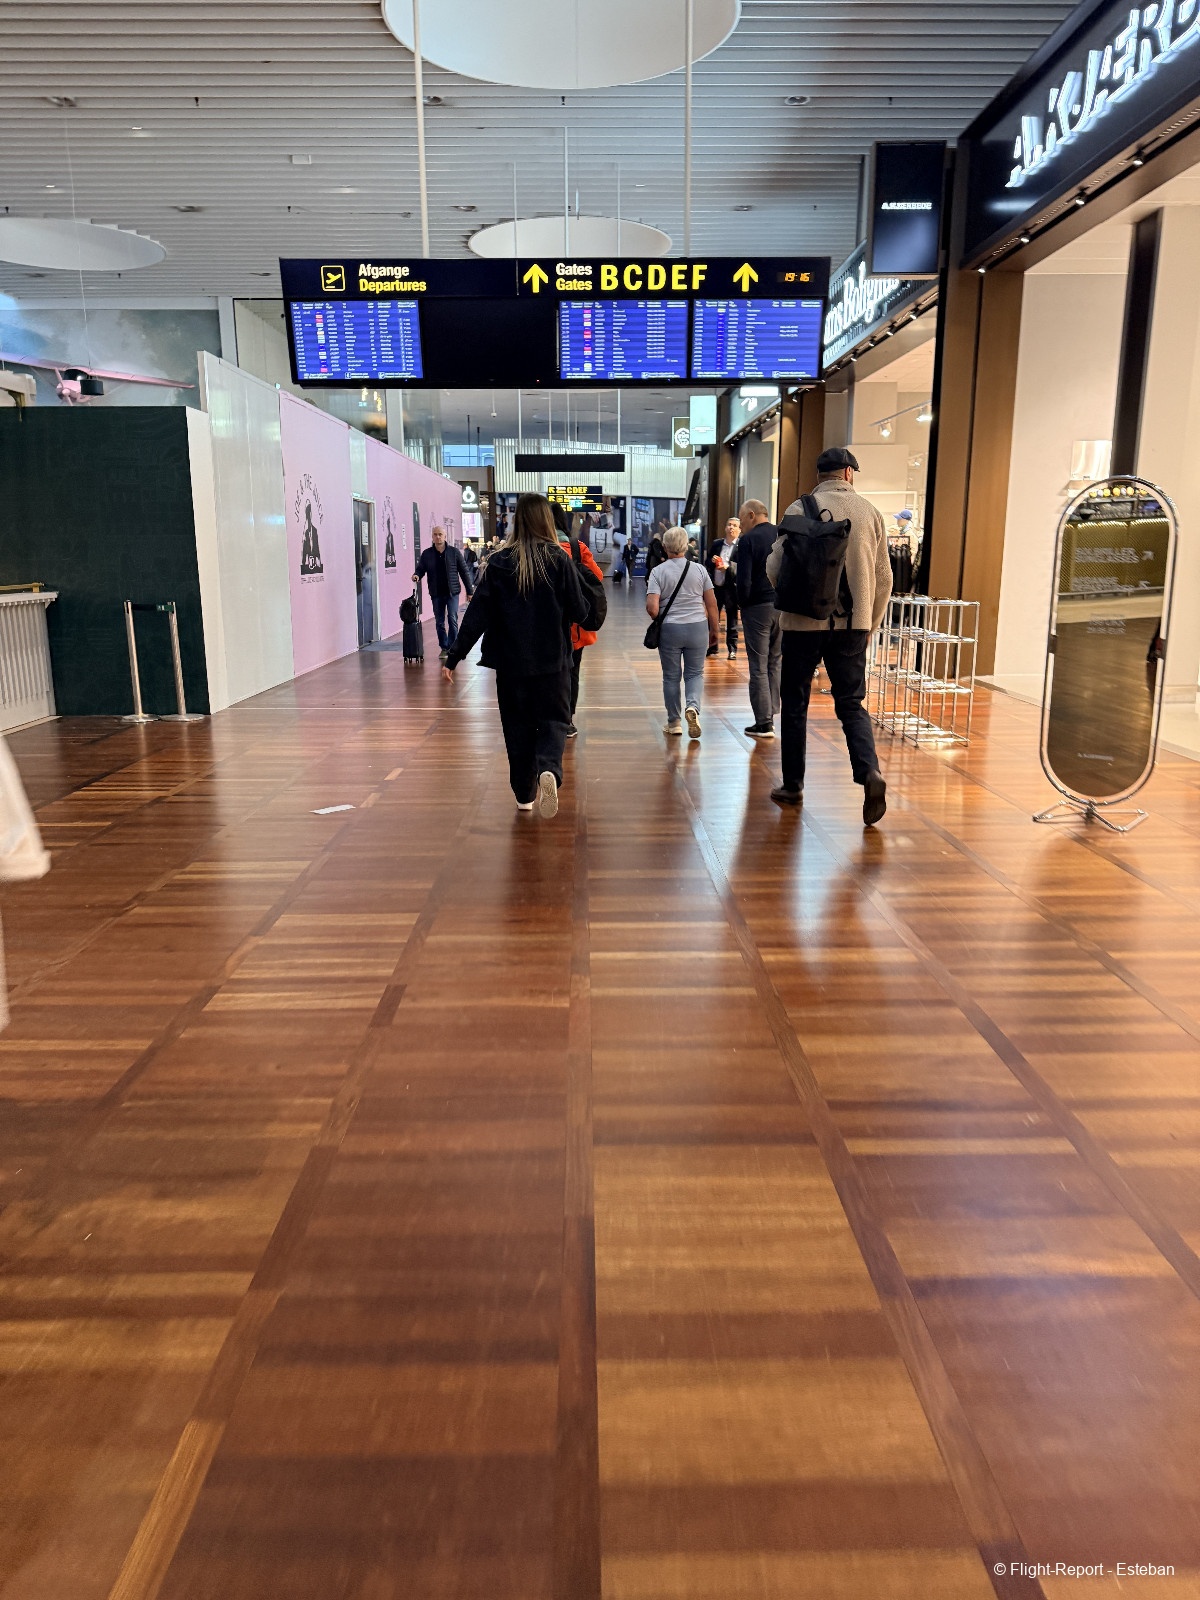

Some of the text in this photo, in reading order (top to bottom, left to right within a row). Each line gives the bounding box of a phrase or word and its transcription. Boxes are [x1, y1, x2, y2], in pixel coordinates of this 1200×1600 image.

[358, 263, 410, 279] Afgange
[555, 262, 593, 276] Gates
[358, 278, 427, 294] Departures
[555, 277, 593, 291] Gates
